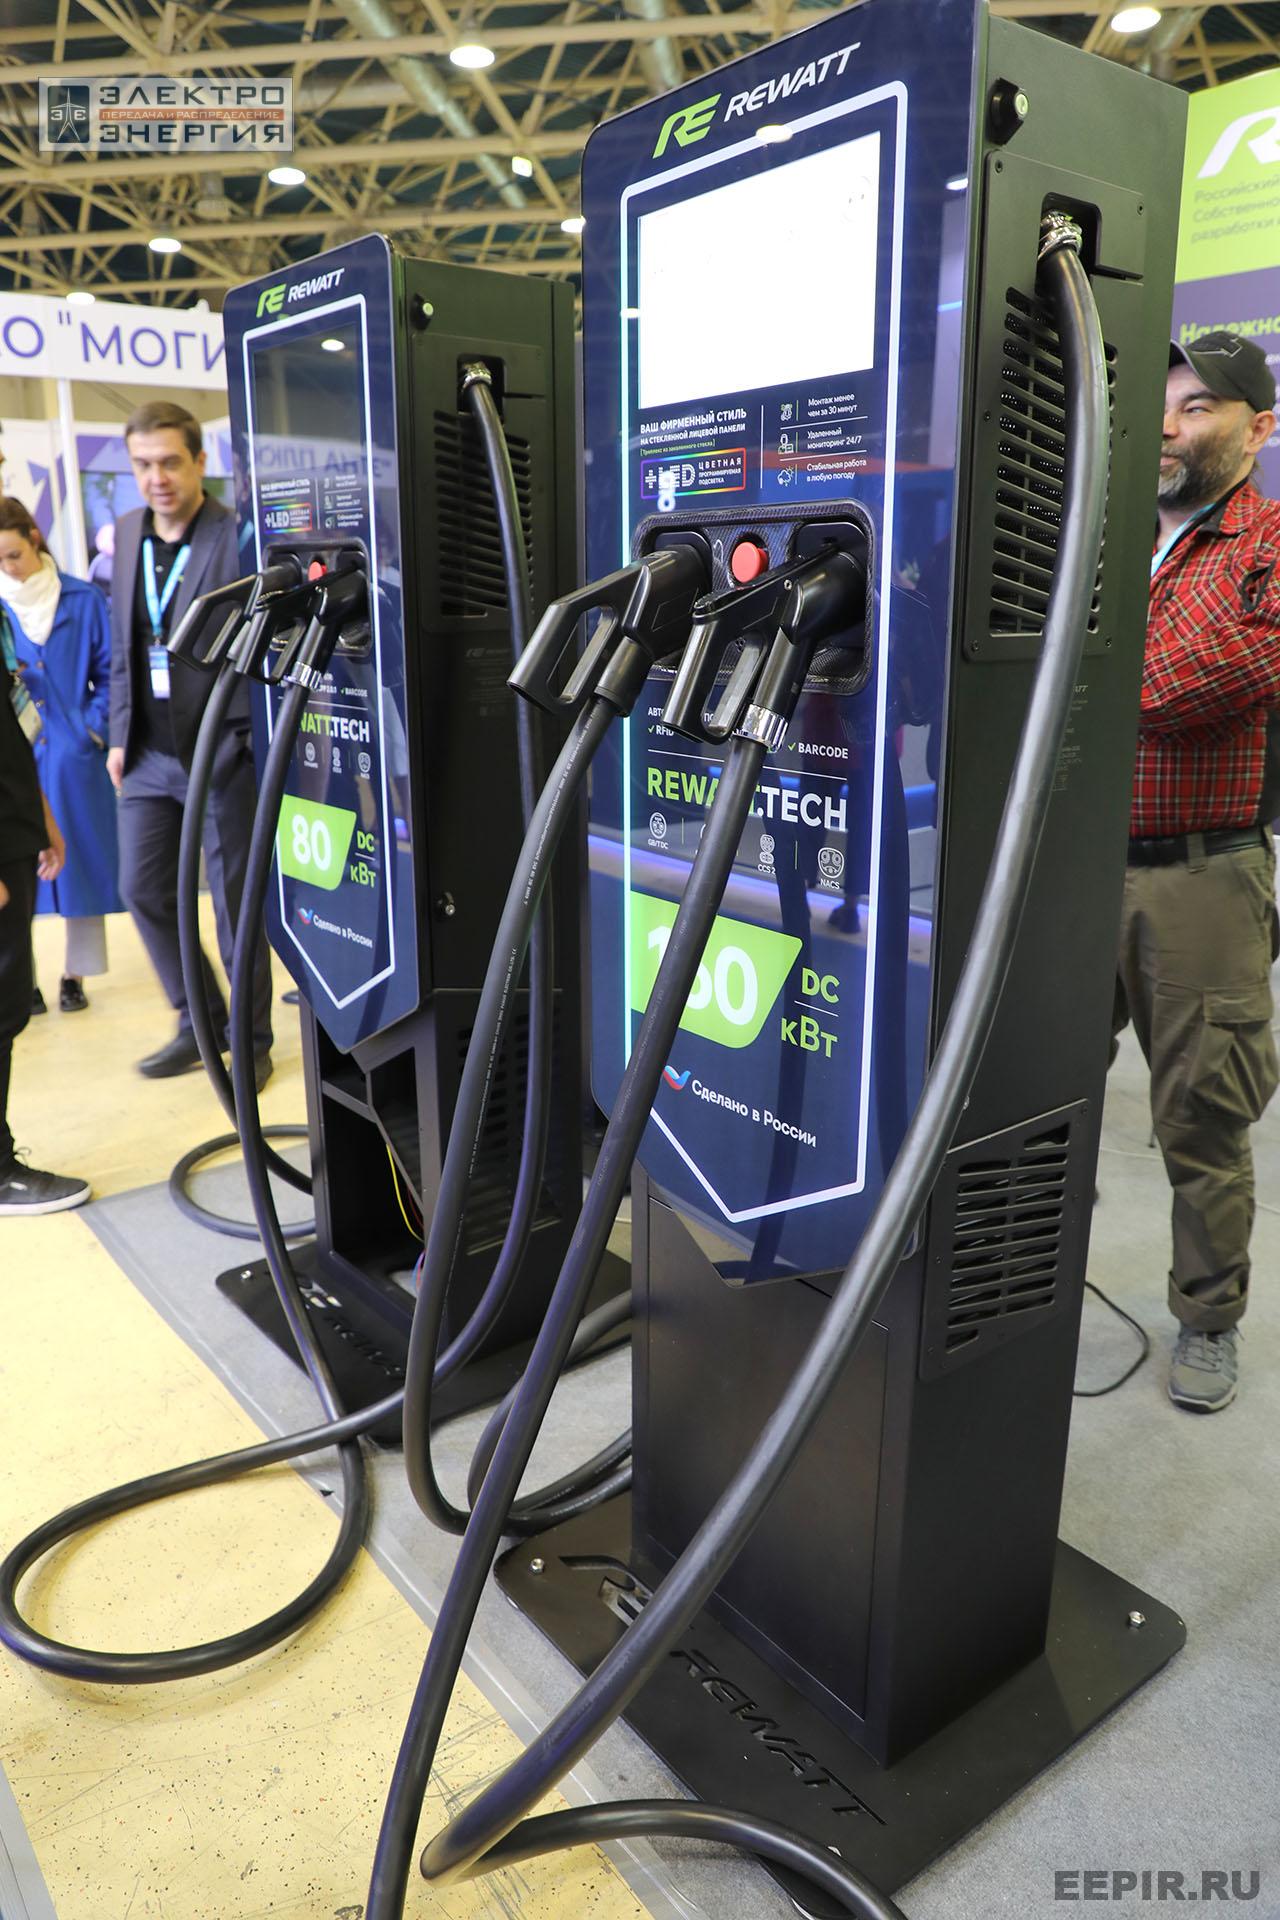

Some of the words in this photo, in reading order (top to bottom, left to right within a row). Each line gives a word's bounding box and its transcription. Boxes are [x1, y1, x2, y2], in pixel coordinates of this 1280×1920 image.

[723, 41, 862, 123] REWATT
[287, 267, 345, 303] REWATT
[807, 410, 820, 418] чем
[820, 408, 828, 416] за
[828, 405, 837, 415] 30
[837, 404, 858, 414] минут
[808, 397, 834, 407] Монтаж
[833, 393, 855, 403] менее
[640, 421, 659, 434] ВАШ
[660, 409, 715, 430] ФИРМЕННЫЙ
[716, 407, 747, 422] СТИЛЬ
[640, 437, 649, 446] НА
[649, 430, 689, 445] СТЕКЛЯННОЙ
[689, 425, 719, 439] ЛИЦЕВОЙ
[719, 423, 746, 434] ПАНЕЛИ
[807, 427, 842, 440] Удаленный
[807, 438, 846, 450] мониторинг
[845, 435, 863, 446] 24/7
[698, 457, 742, 470] ЦВЕТНАЯ
[806, 461, 844, 472] Стабильная
[843, 458, 867, 470] работа
[810, 473, 833, 483] любую
[833, 471, 856, 480] погоду
[798, 742, 849, 760] BARCODE
[292, 813, 333, 872] 80
[356, 830, 376, 853] DC
[350, 861, 376, 888] кВт
[757, 863, 771, 874] CCS
[820, 877, 841, 890] NACS
[312, 914, 341, 936] Сделано
[341, 928, 347, 939] в
[347, 926, 374, 949] России
[801, 966, 840, 1004] DC
[780, 1014, 839, 1059] кВт
[691, 1078, 749, 1117] Сделано
[752, 1108, 760, 1122] в
[763, 1109, 818, 1149] России
